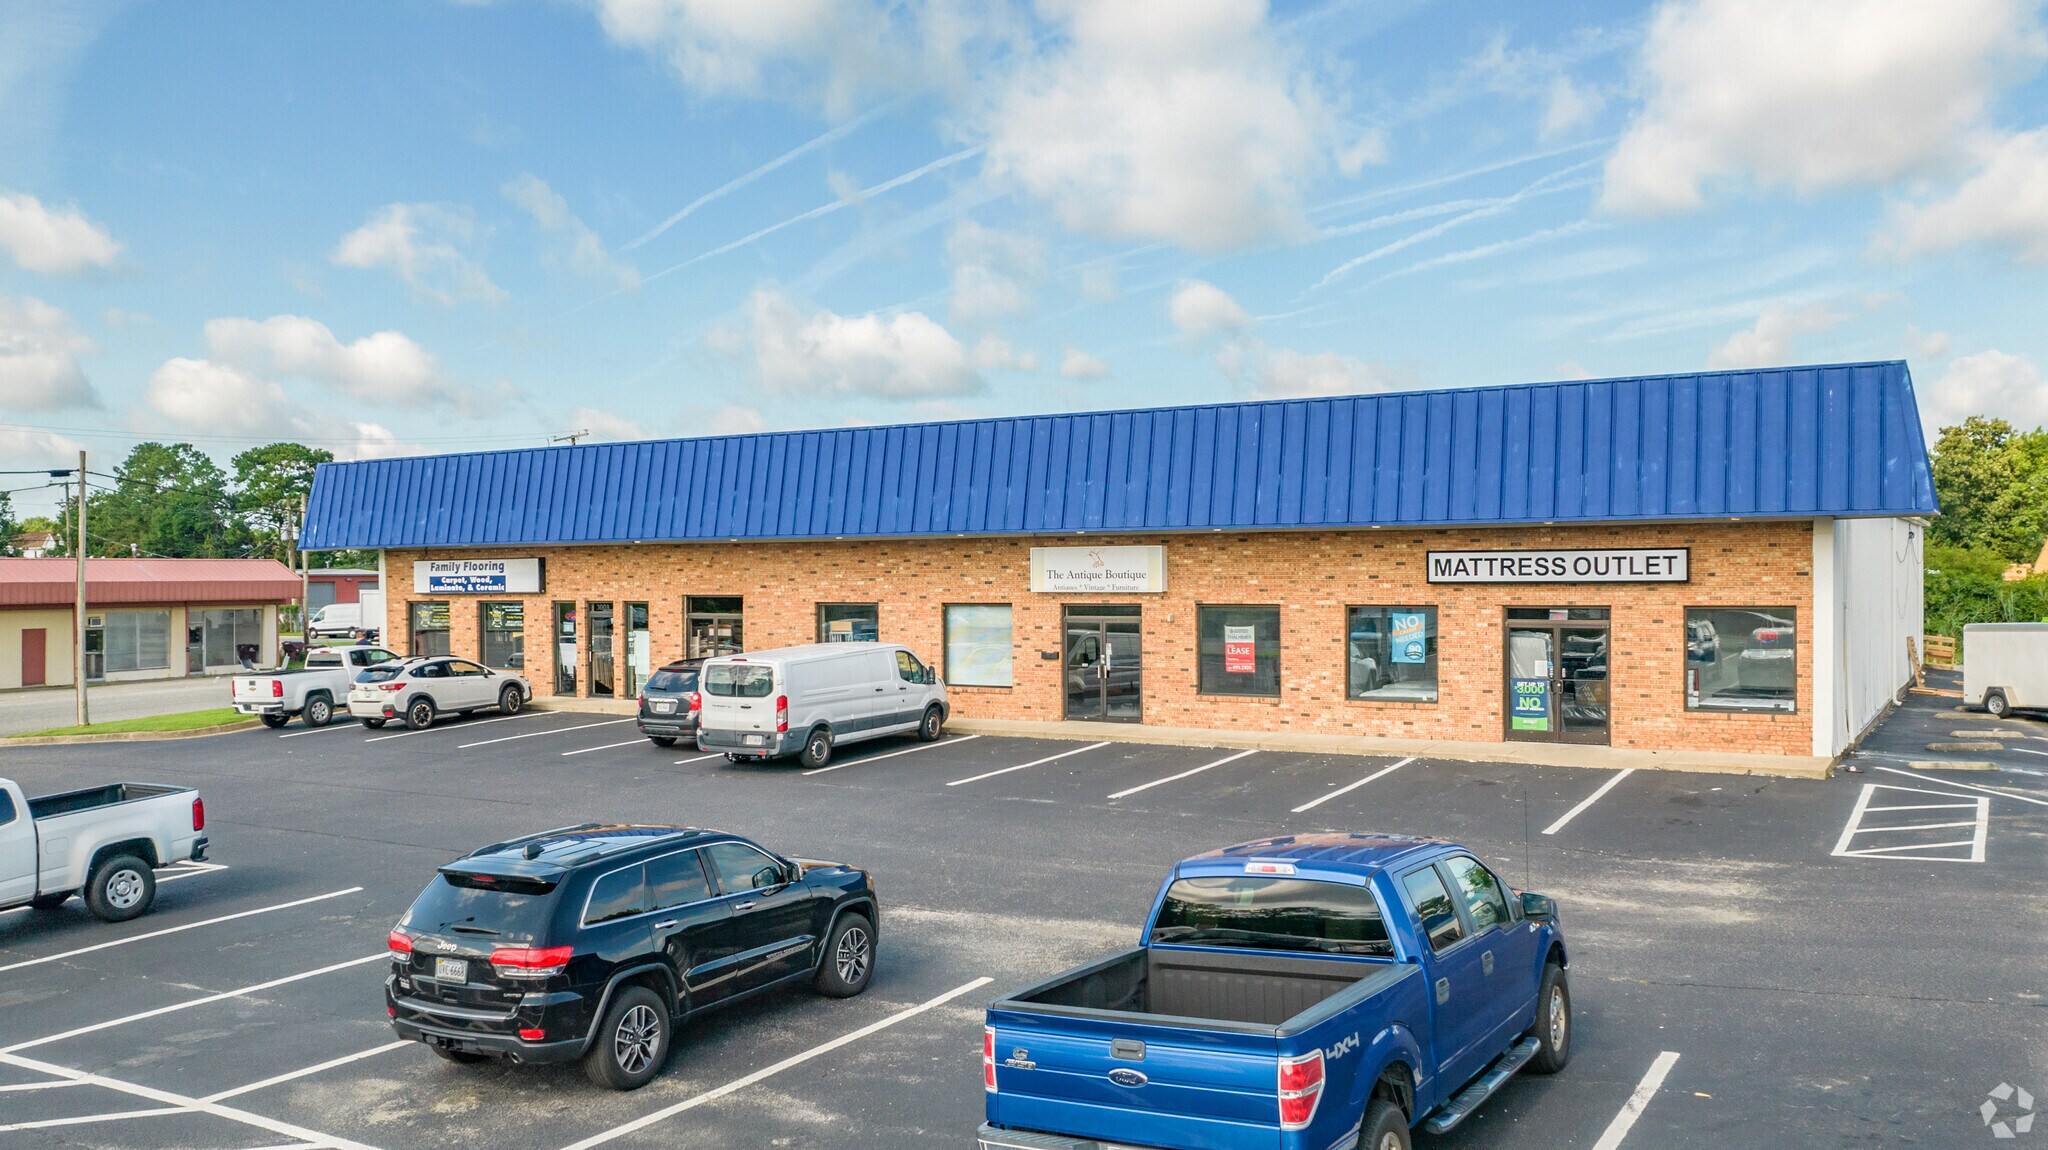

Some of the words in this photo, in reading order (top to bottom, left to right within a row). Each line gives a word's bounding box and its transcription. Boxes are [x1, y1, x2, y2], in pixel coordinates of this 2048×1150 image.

[430, 561, 460, 574] Family
[463, 561, 505, 574] Flooring
[1434, 557, 1567, 577] MATTRESS
[1573, 555, 1678, 576] OUTLET
[441, 576, 468, 585] Carpet,
[470, 575, 493, 584] Wood,
[1046, 569, 1064, 580] The
[1066, 569, 1103, 582] Antique
[1105, 568, 1147, 582] Boutique
[430, 584, 466, 593] Laminate,
[467, 584, 474, 592] &
[475, 583, 505, 592] Ceramic
[1052, 584, 1078, 592] Antiques
[1083, 584, 1106, 592] Vintage
[1111, 583, 1140, 591] Furniture
[1394, 615, 1420, 631] NO
[1395, 631, 1425, 645] NEEDED
[1519, 697, 1541, 709] NO
[437, 940, 457, 952] Jeep
[1115, 1073, 1137, 1085] Ford
